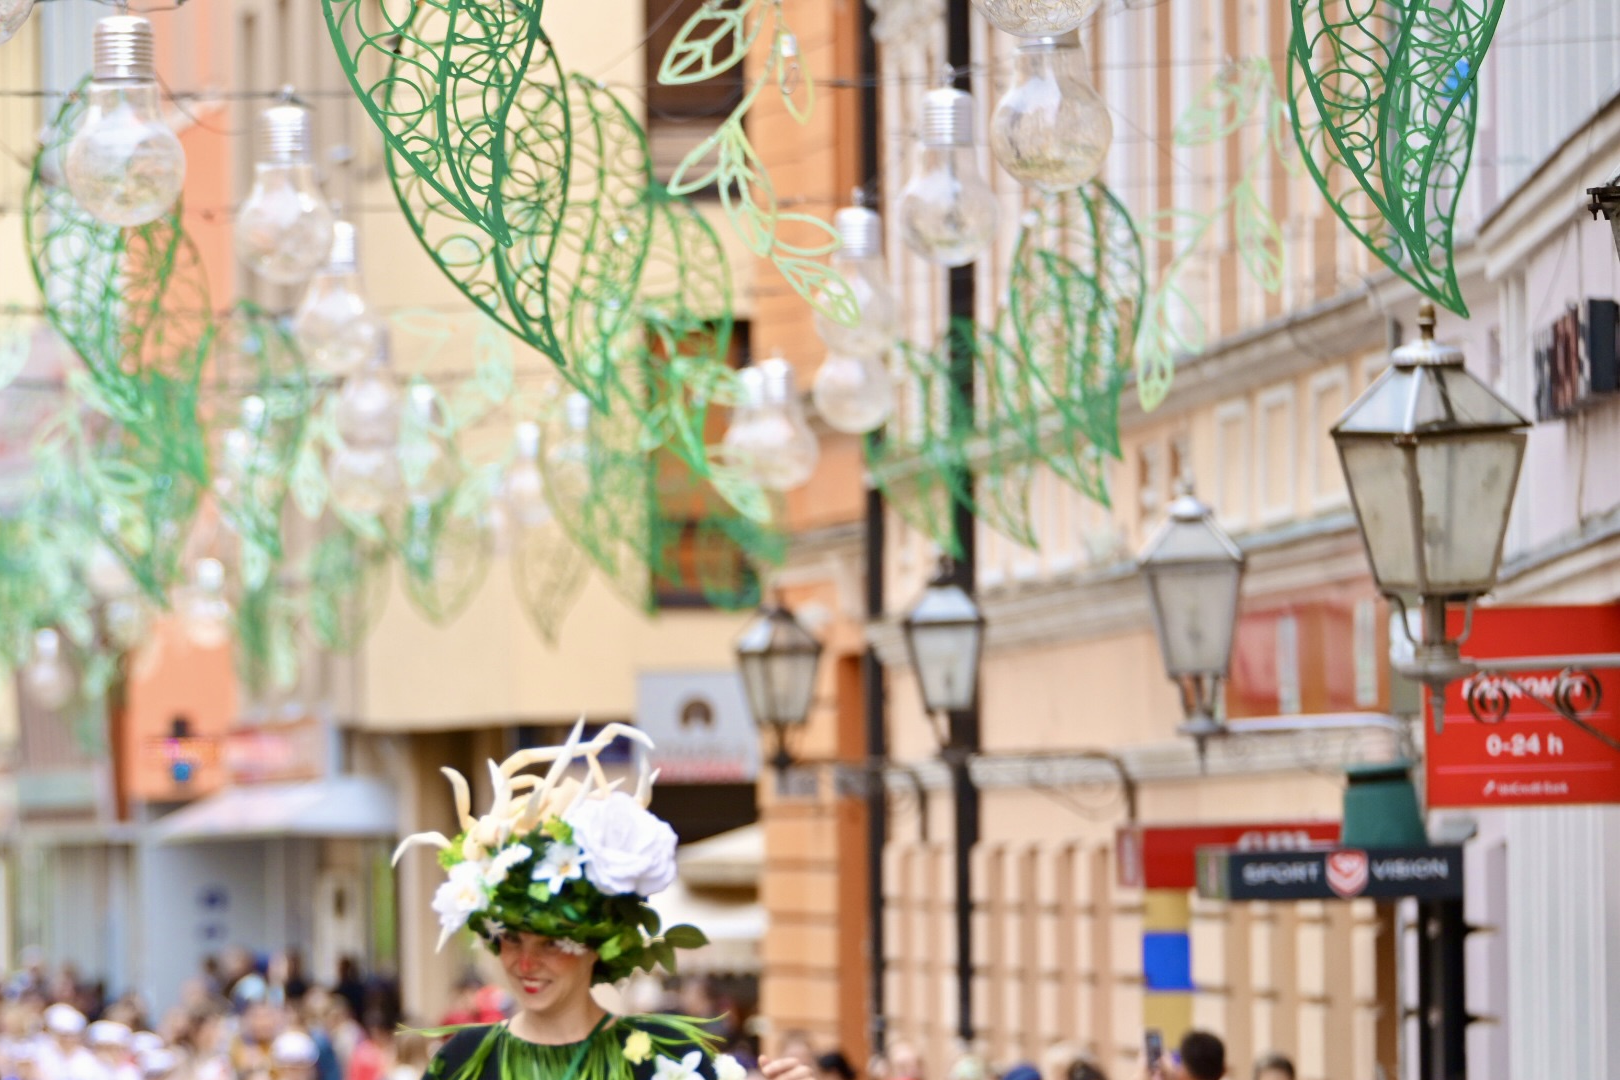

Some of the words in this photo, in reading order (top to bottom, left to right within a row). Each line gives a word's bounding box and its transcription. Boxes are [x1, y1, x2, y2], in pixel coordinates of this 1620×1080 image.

[1486, 733, 1541, 756] 0-24
[1547, 732, 1563, 755] h
[1242, 861, 1320, 884] SPORT
[1372, 858, 1448, 881] VISION
